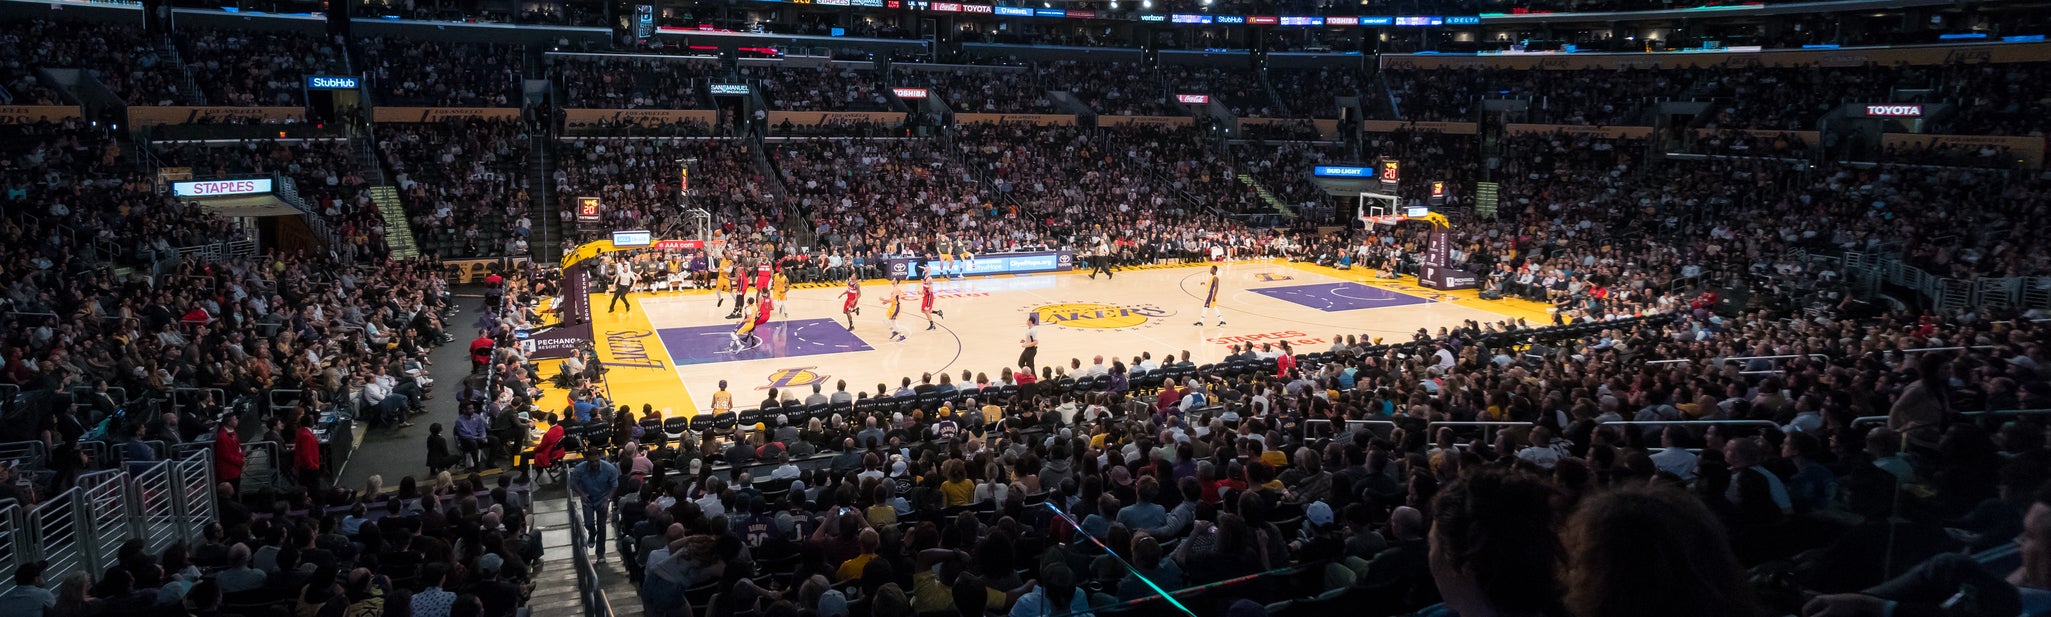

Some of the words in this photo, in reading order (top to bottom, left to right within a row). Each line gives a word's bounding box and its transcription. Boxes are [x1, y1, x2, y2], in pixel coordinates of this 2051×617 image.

[963, 4, 992, 13] TOYOTA
[314, 78, 355, 88] StubHub
[1866, 105, 1920, 115] TOYOTA
[1384, 168, 1396, 179] 20
[194, 181, 254, 194] STAPLES
[583, 206, 595, 214] 20
[582, 273, 590, 321] PECHANGA.COM
[1017, 305, 1177, 326] LAKERS
[537, 338, 580, 346] PECHANG
[1206, 331, 1306, 344] STAPLES
[594, 427, 610, 436] DELTA
